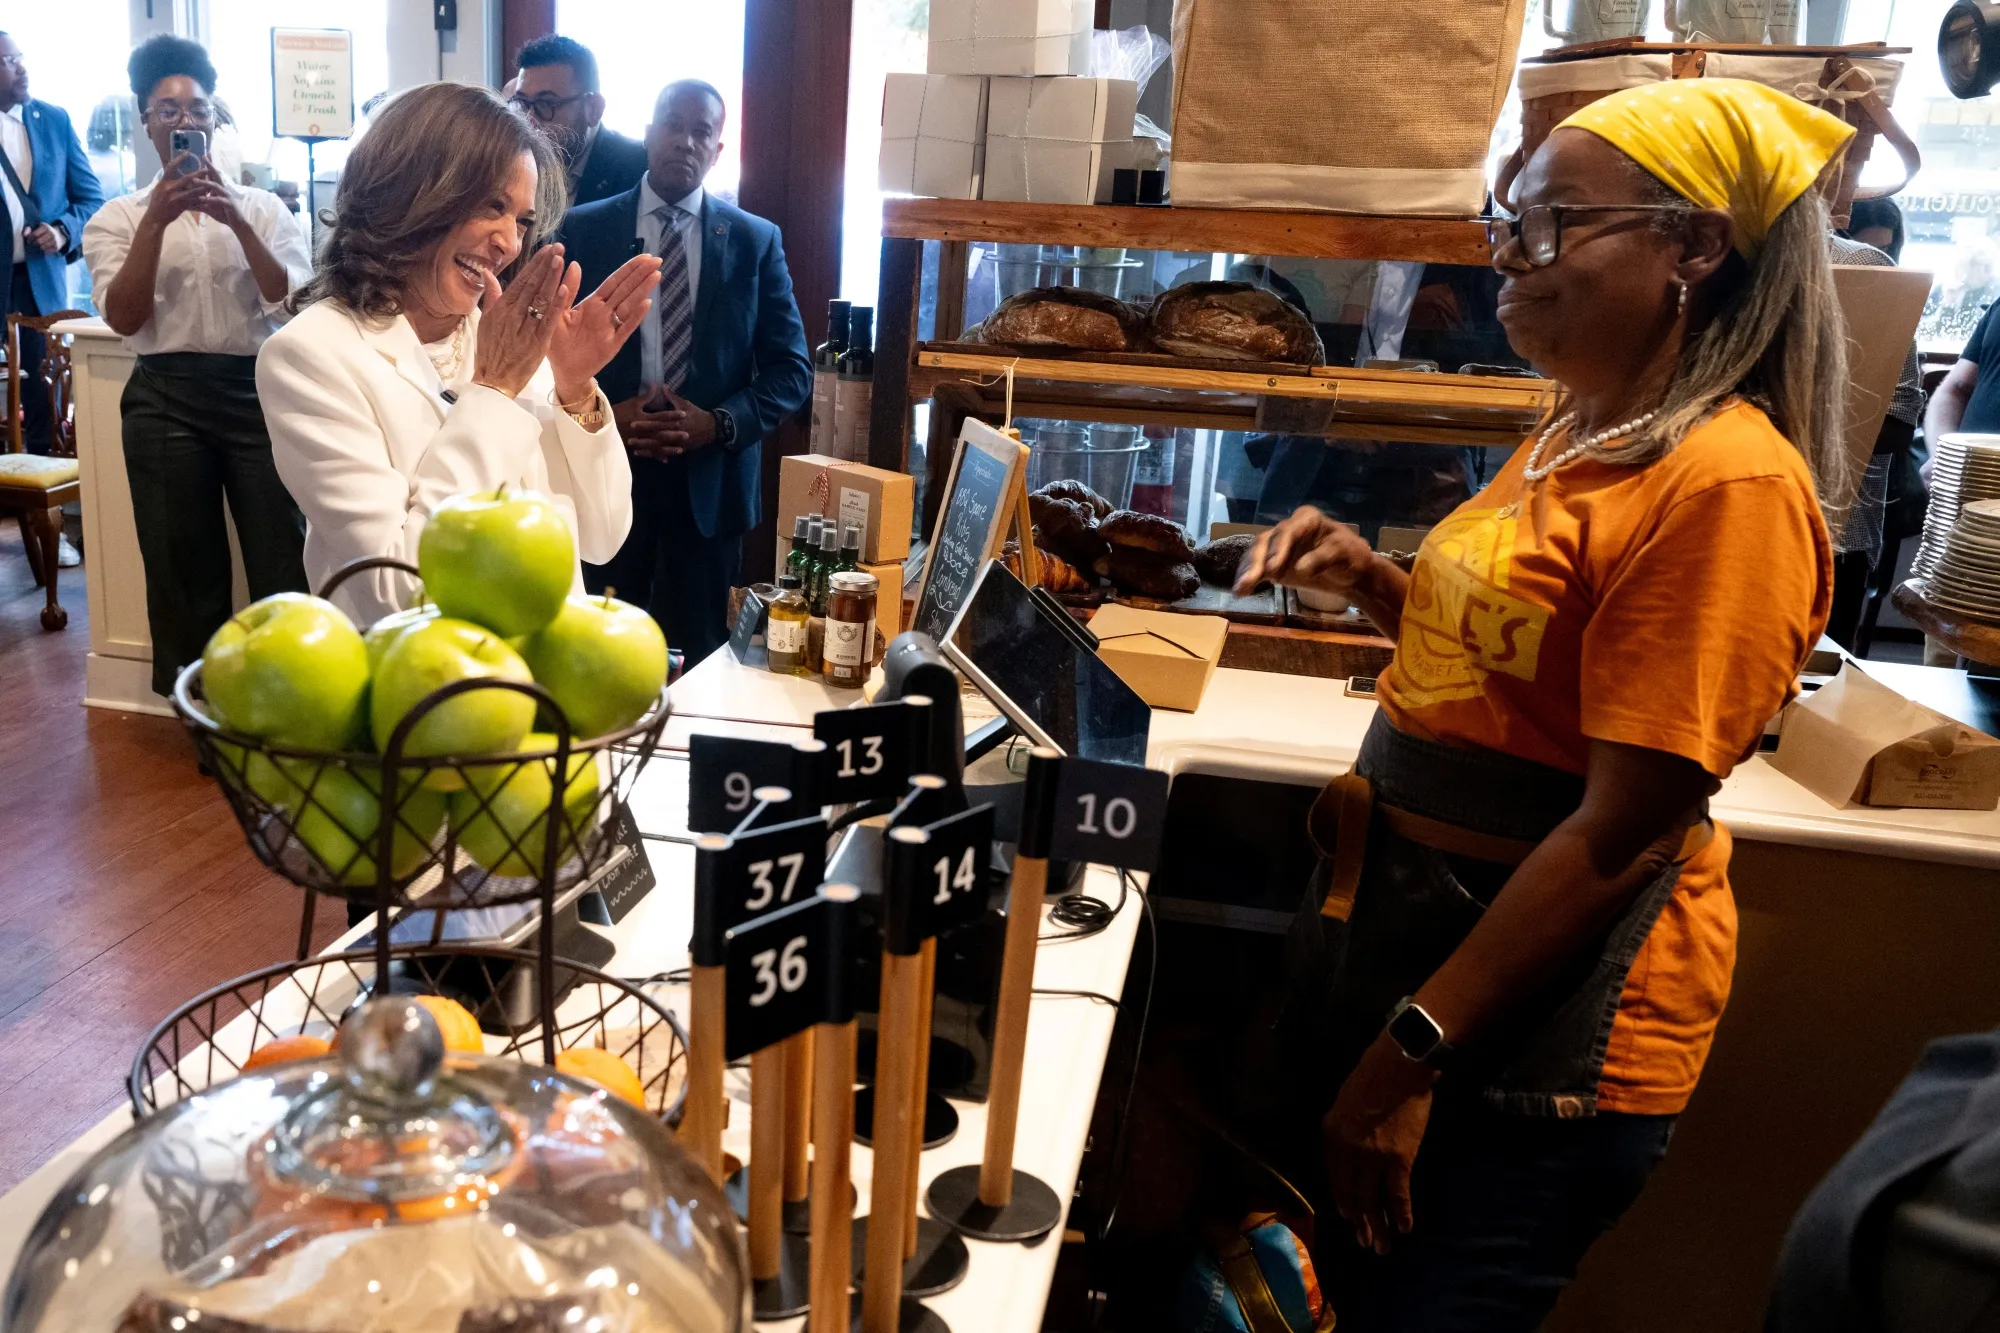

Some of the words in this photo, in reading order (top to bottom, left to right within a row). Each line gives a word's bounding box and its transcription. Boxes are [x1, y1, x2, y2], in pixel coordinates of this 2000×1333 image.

[297, 60, 331, 71] Water
[307, 104, 337, 115] Trash
[956, 487, 971, 512] BBQ
[969, 492, 987, 520] Spare
[955, 512, 970, 543] Ribs
[936, 563, 965, 602] Cornbread
[836, 735, 884, 778] 13
[724, 772, 752, 811] 9
[1077, 793, 1137, 839] 10
[745, 853, 805, 911] 37
[934, 847, 976, 905] 14
[749, 936, 808, 1007] 36
